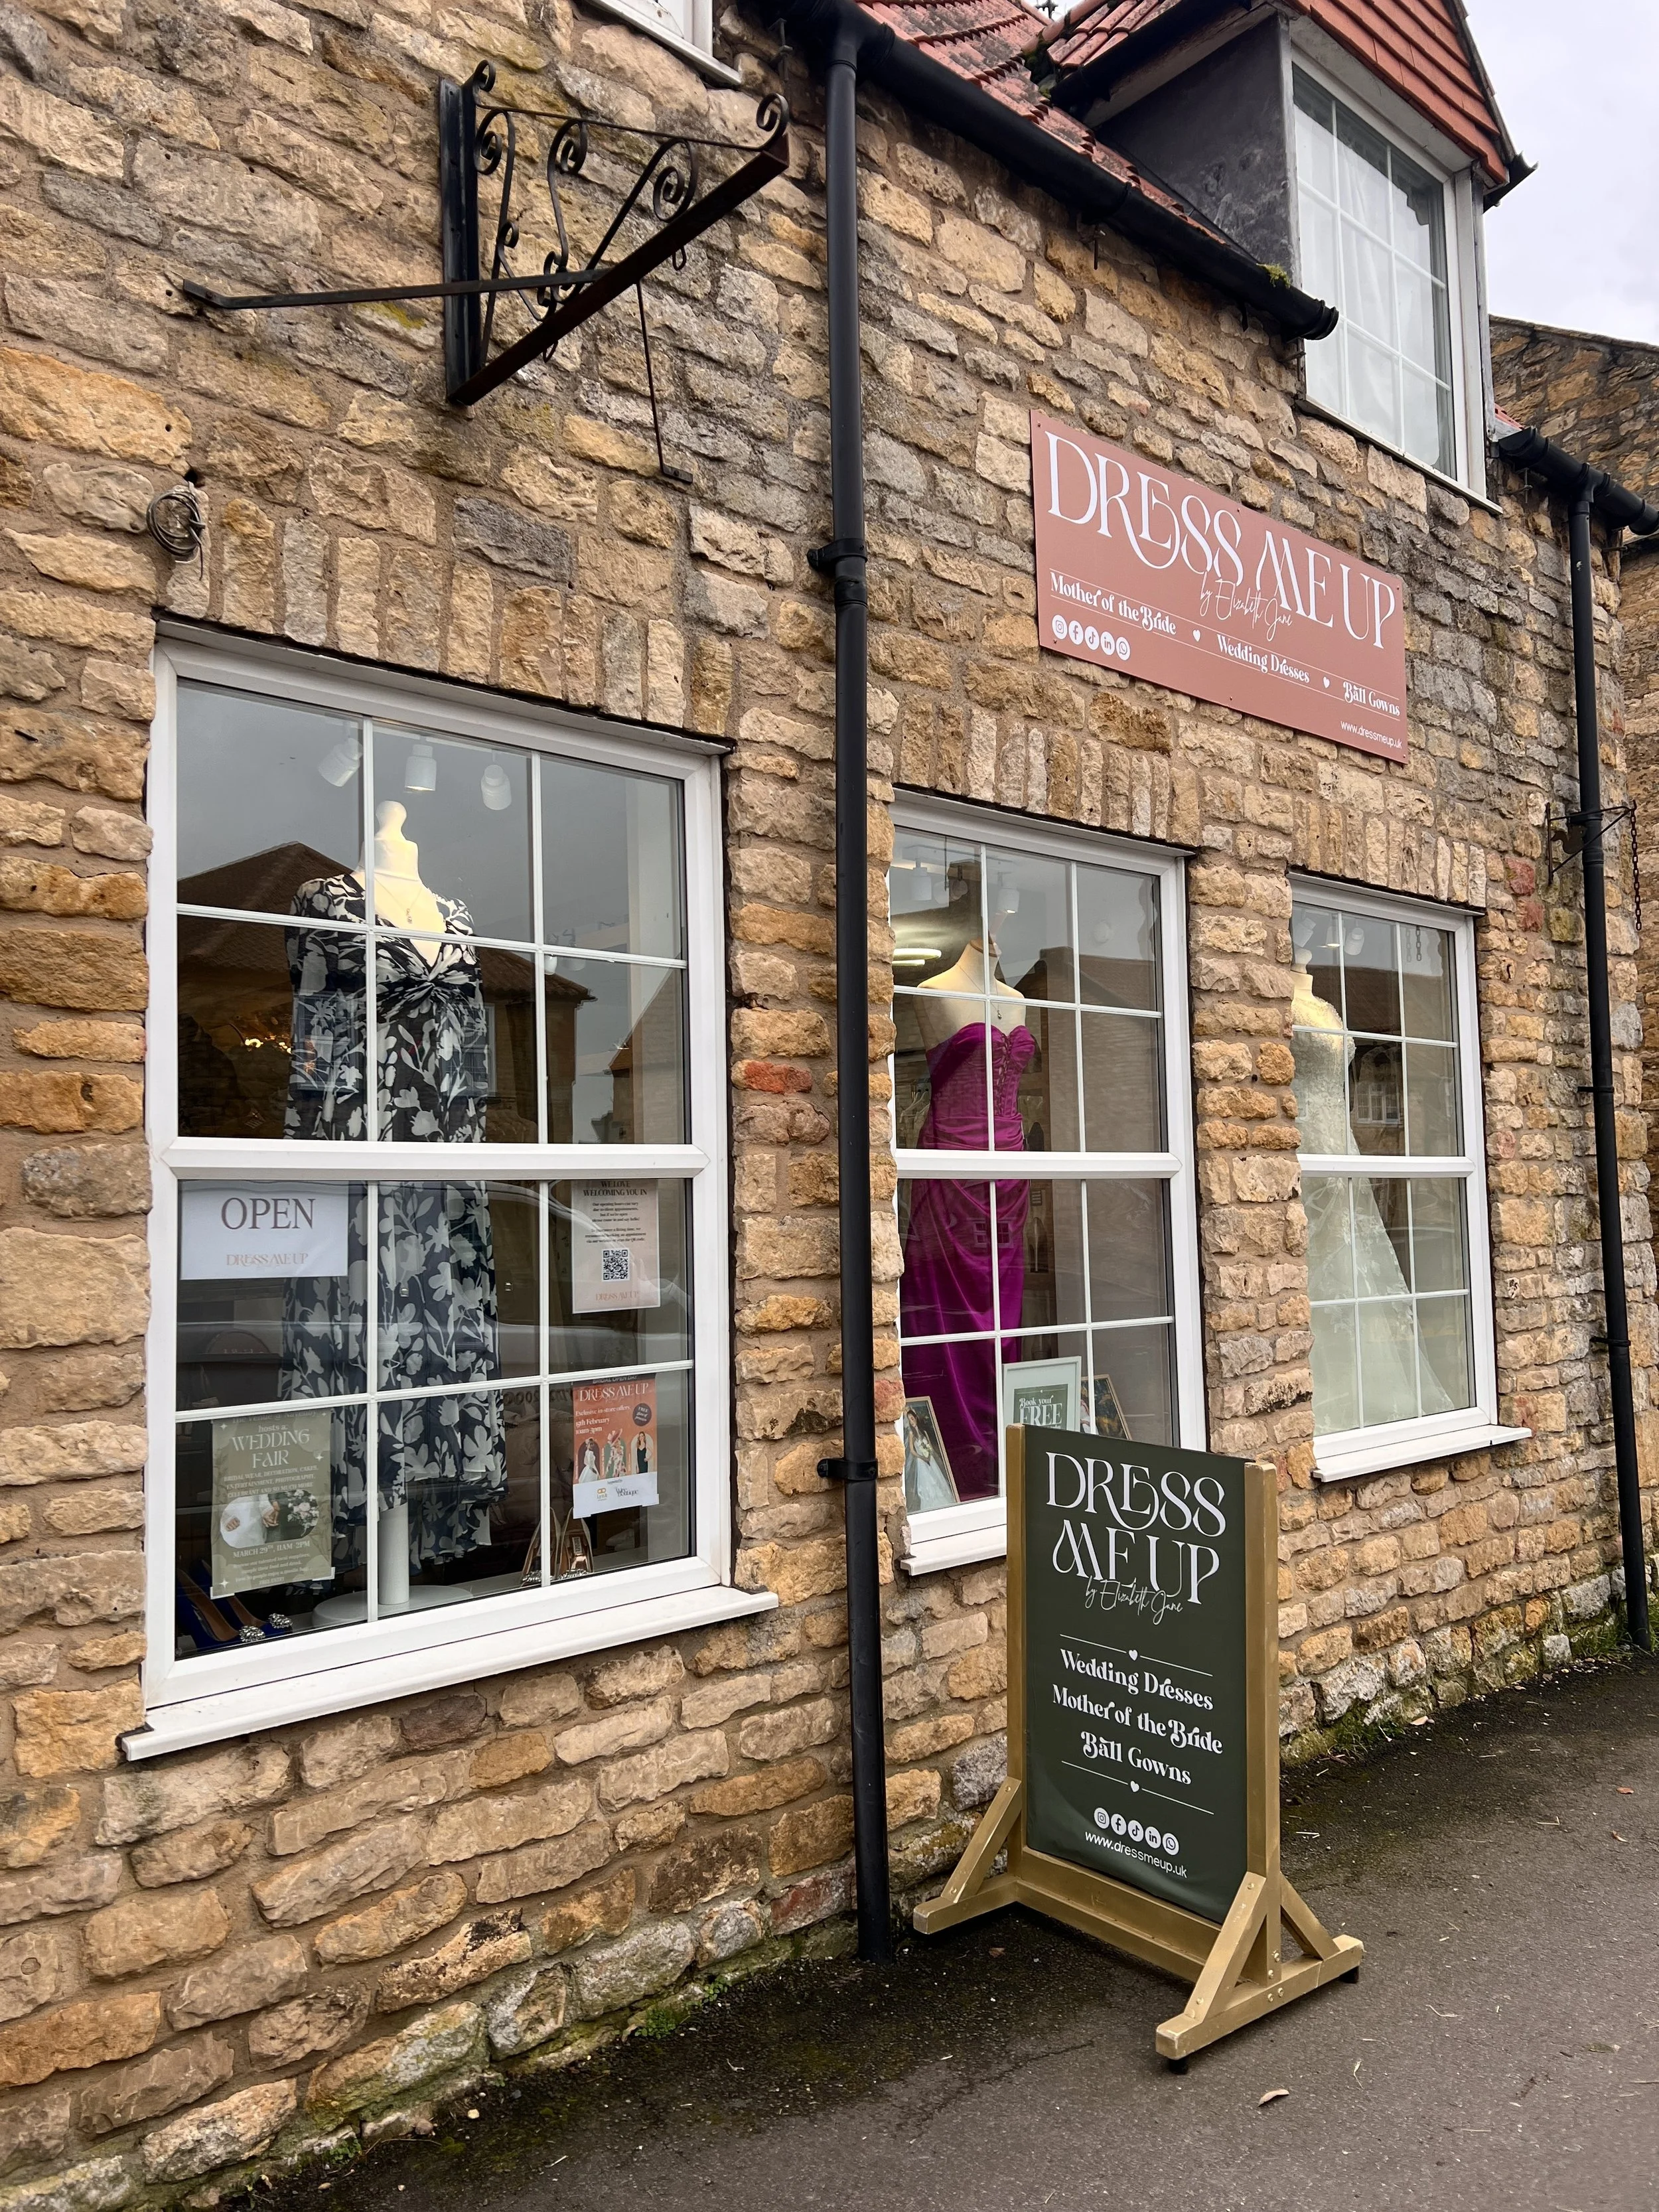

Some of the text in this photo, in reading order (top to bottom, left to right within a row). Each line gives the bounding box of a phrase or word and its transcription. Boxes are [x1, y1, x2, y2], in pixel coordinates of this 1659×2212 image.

[1045, 431, 1395, 648] DRESS ME UP
[1050, 571, 1177, 635] Mother of the Bride
[1200, 571, 1293, 641] by Elizabeth Jane
[1216, 634, 1311, 684] Wedding Dresses
[1343, 680, 1400, 717] Ball Gowns
[1340, 720, 1403, 749] www.dressmeup.uk
[221, 1197, 316, 1229] OPEN
[226, 1252, 309, 1267] DRESS ME UP
[579, 1386, 615, 1402] DRESS
[616, 1384, 634, 1398] ME
[635, 1382, 649, 1394] UP
[1019, 1395, 1054, 1409] Book your
[1019, 1403, 1062, 1426] FREE
[232, 1428, 310, 1451] WEDDING
[252, 1449, 289, 1468] FAIR
[1045, 1451, 1227, 1537] DRESS
[233, 1548, 258, 1558] MARCH
[1052, 1519, 1220, 1605] ME UP
[1084, 1575, 1183, 1625] by Elizabeth Jane
[1060, 1648, 1214, 1710] Wedding Dresses
[1052, 1684, 1223, 1754] Mother of the Bride
[1080, 1731, 1192, 1785] Ball Gowns
[1085, 1830, 1188, 1879] www.dressmeup.uk
